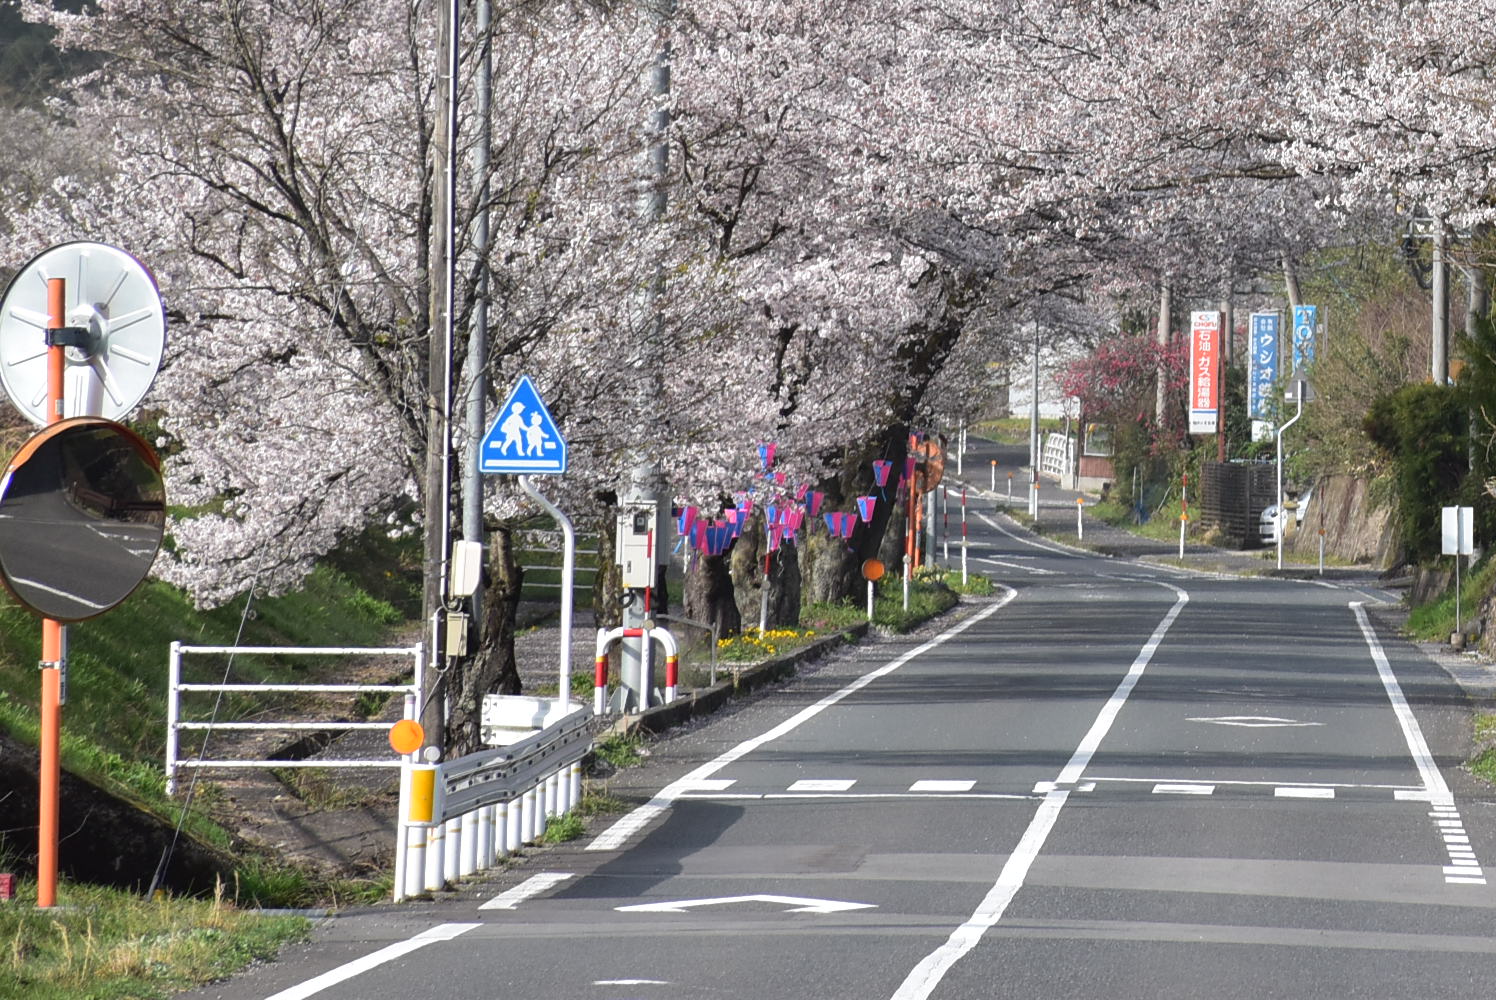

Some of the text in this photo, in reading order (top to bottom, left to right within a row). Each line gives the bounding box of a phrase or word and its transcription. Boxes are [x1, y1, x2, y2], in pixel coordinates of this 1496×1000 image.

[1198, 331, 1211, 408] 石油・ガス給湯器
